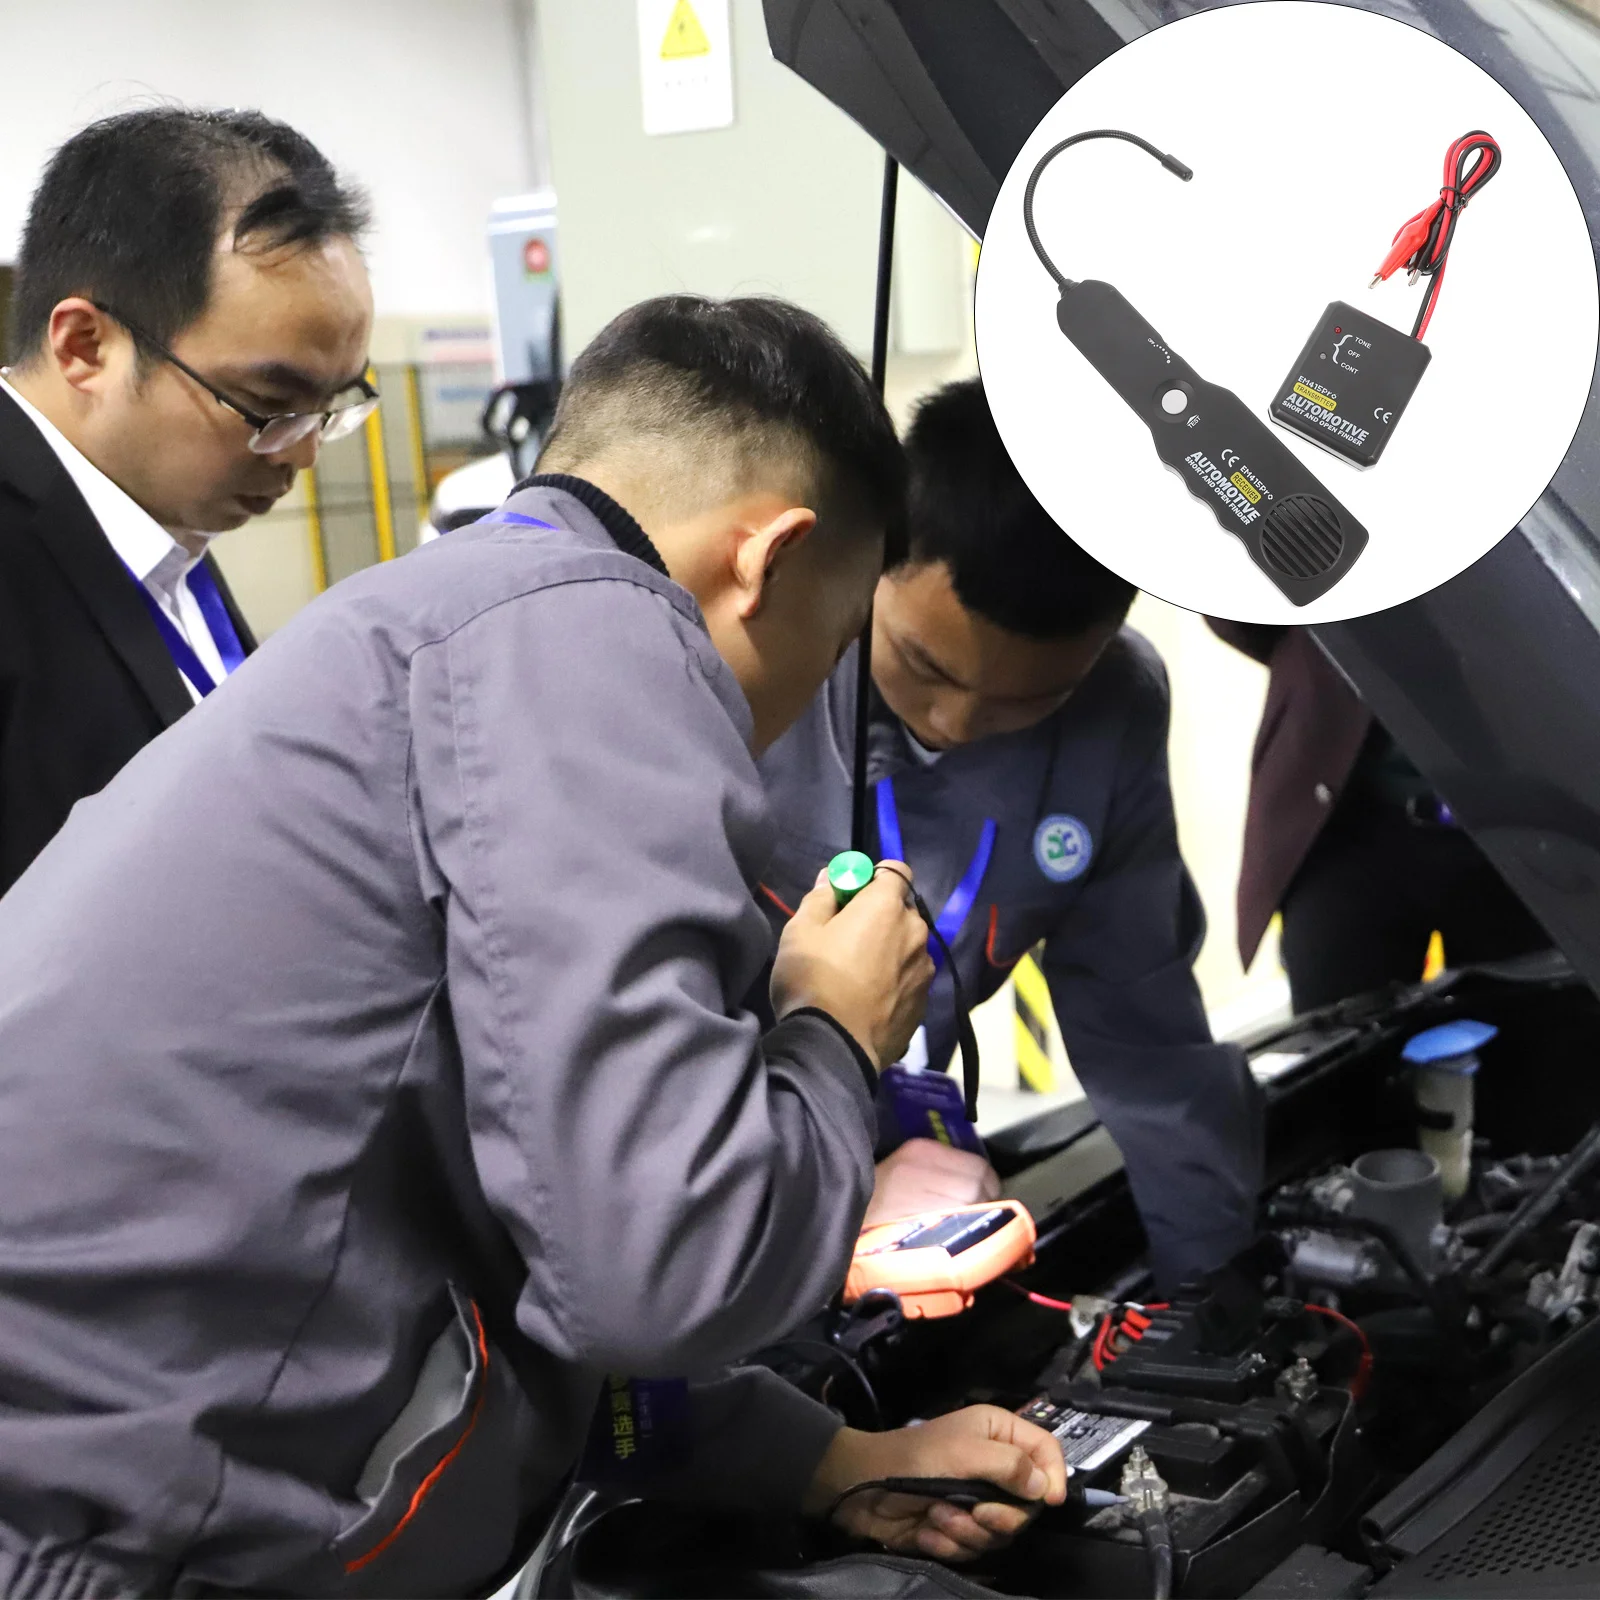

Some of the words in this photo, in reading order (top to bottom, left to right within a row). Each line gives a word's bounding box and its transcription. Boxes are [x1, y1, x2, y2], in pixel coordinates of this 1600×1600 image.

[1347, 349, 1361, 359] OFF
[1354, 336, 1372, 349] TONE
[1340, 362, 1359, 375] CONT
[1296, 384, 1335, 408] TRANSMITTER
[1297, 375, 1337, 400] EM415Pro
[1187, 416, 1201, 429] TEST
[1282, 400, 1305, 415] SHORT
[1303, 412, 1319, 423] AND
[1318, 420, 1338, 433] OPEN
[1337, 430, 1363, 447] FINDER
[1286, 392, 1370, 442] AUTOMOTIVE
[1184, 456, 1205, 476] SHORT
[1201, 475, 1216, 488] AND
[1213, 487, 1232, 504] OPEN
[1228, 502, 1251, 526] FINDER
[1190, 451, 1261, 522] AUTOMOTIVE
[1232, 474, 1259, 502] RECEIVER
[1239, 464, 1274, 500] EM415Pro
